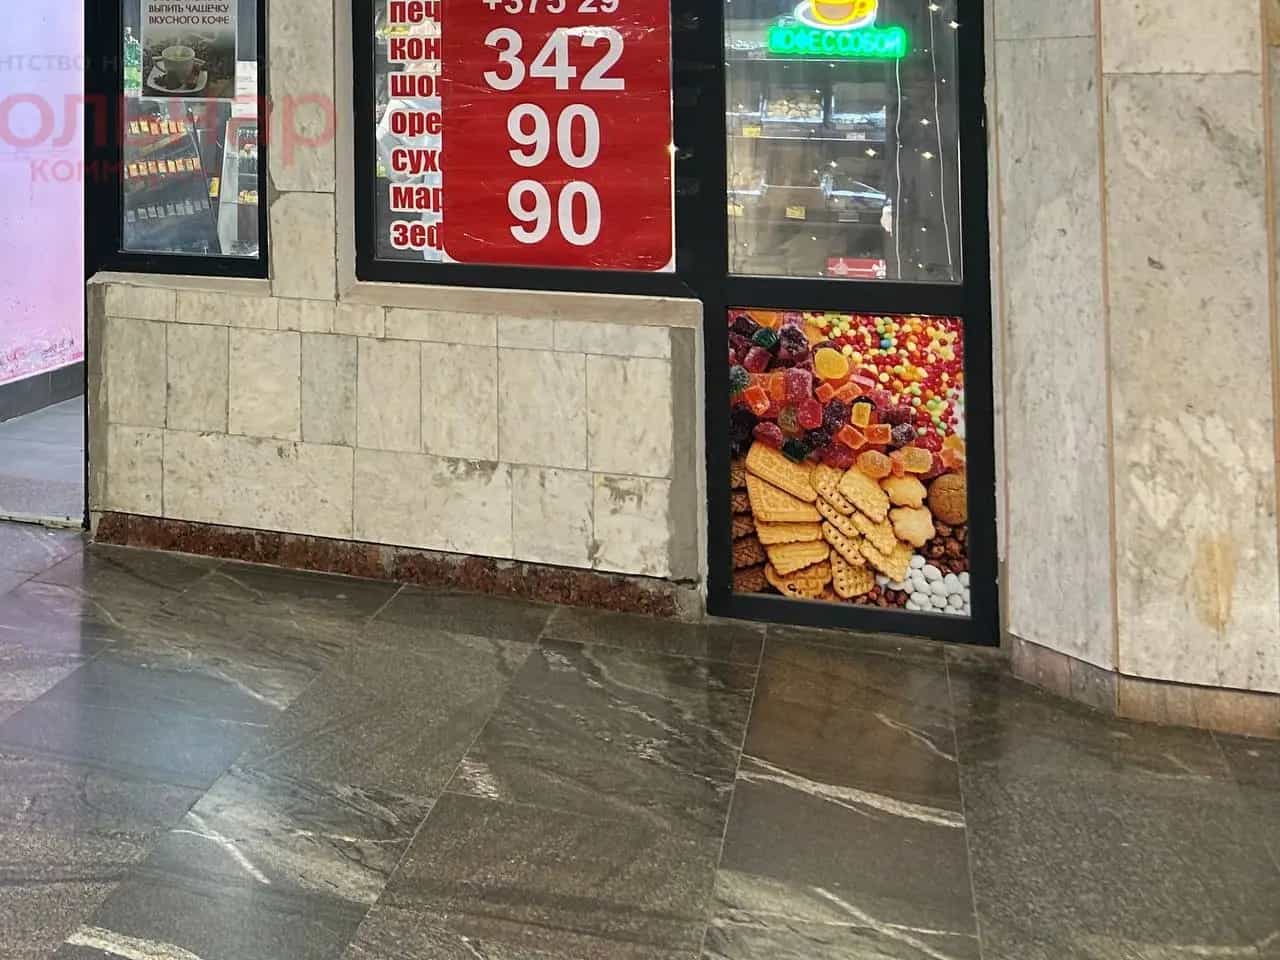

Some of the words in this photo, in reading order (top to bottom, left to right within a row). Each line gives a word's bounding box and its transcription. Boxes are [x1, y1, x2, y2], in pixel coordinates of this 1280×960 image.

[148, 4, 184, 14] ВЫПИТЬ
[148, 15, 200, 25] ВКУСНОГО
[201, 15, 230, 25] КОФЕ
[483, 27, 625, 90] 342
[506, 102, 601, 168] 90
[392, 148, 442, 175] сух
[507, 178, 602, 246] 90
